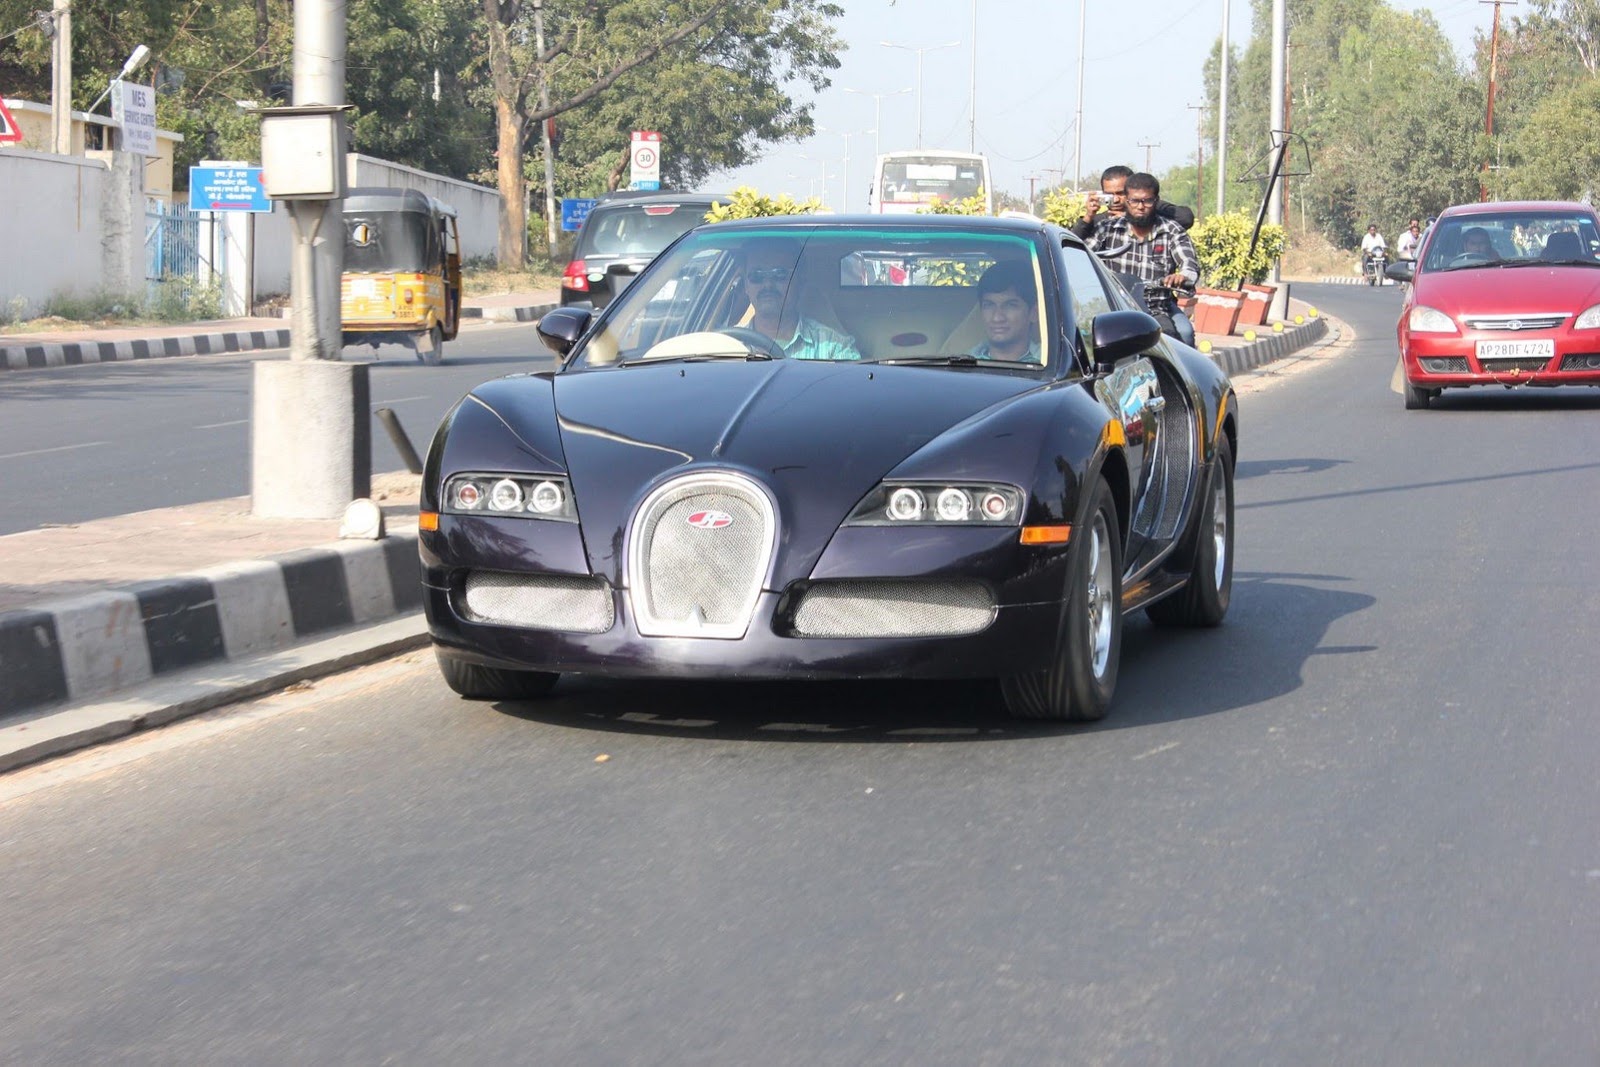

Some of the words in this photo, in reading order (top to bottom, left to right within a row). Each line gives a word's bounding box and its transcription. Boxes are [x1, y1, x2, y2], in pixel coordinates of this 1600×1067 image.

[131, 89, 146, 107] MES
[124, 110, 140, 124] SERVICE
[140, 113, 155, 127] CENTRE
[640, 154, 651, 162] 30
